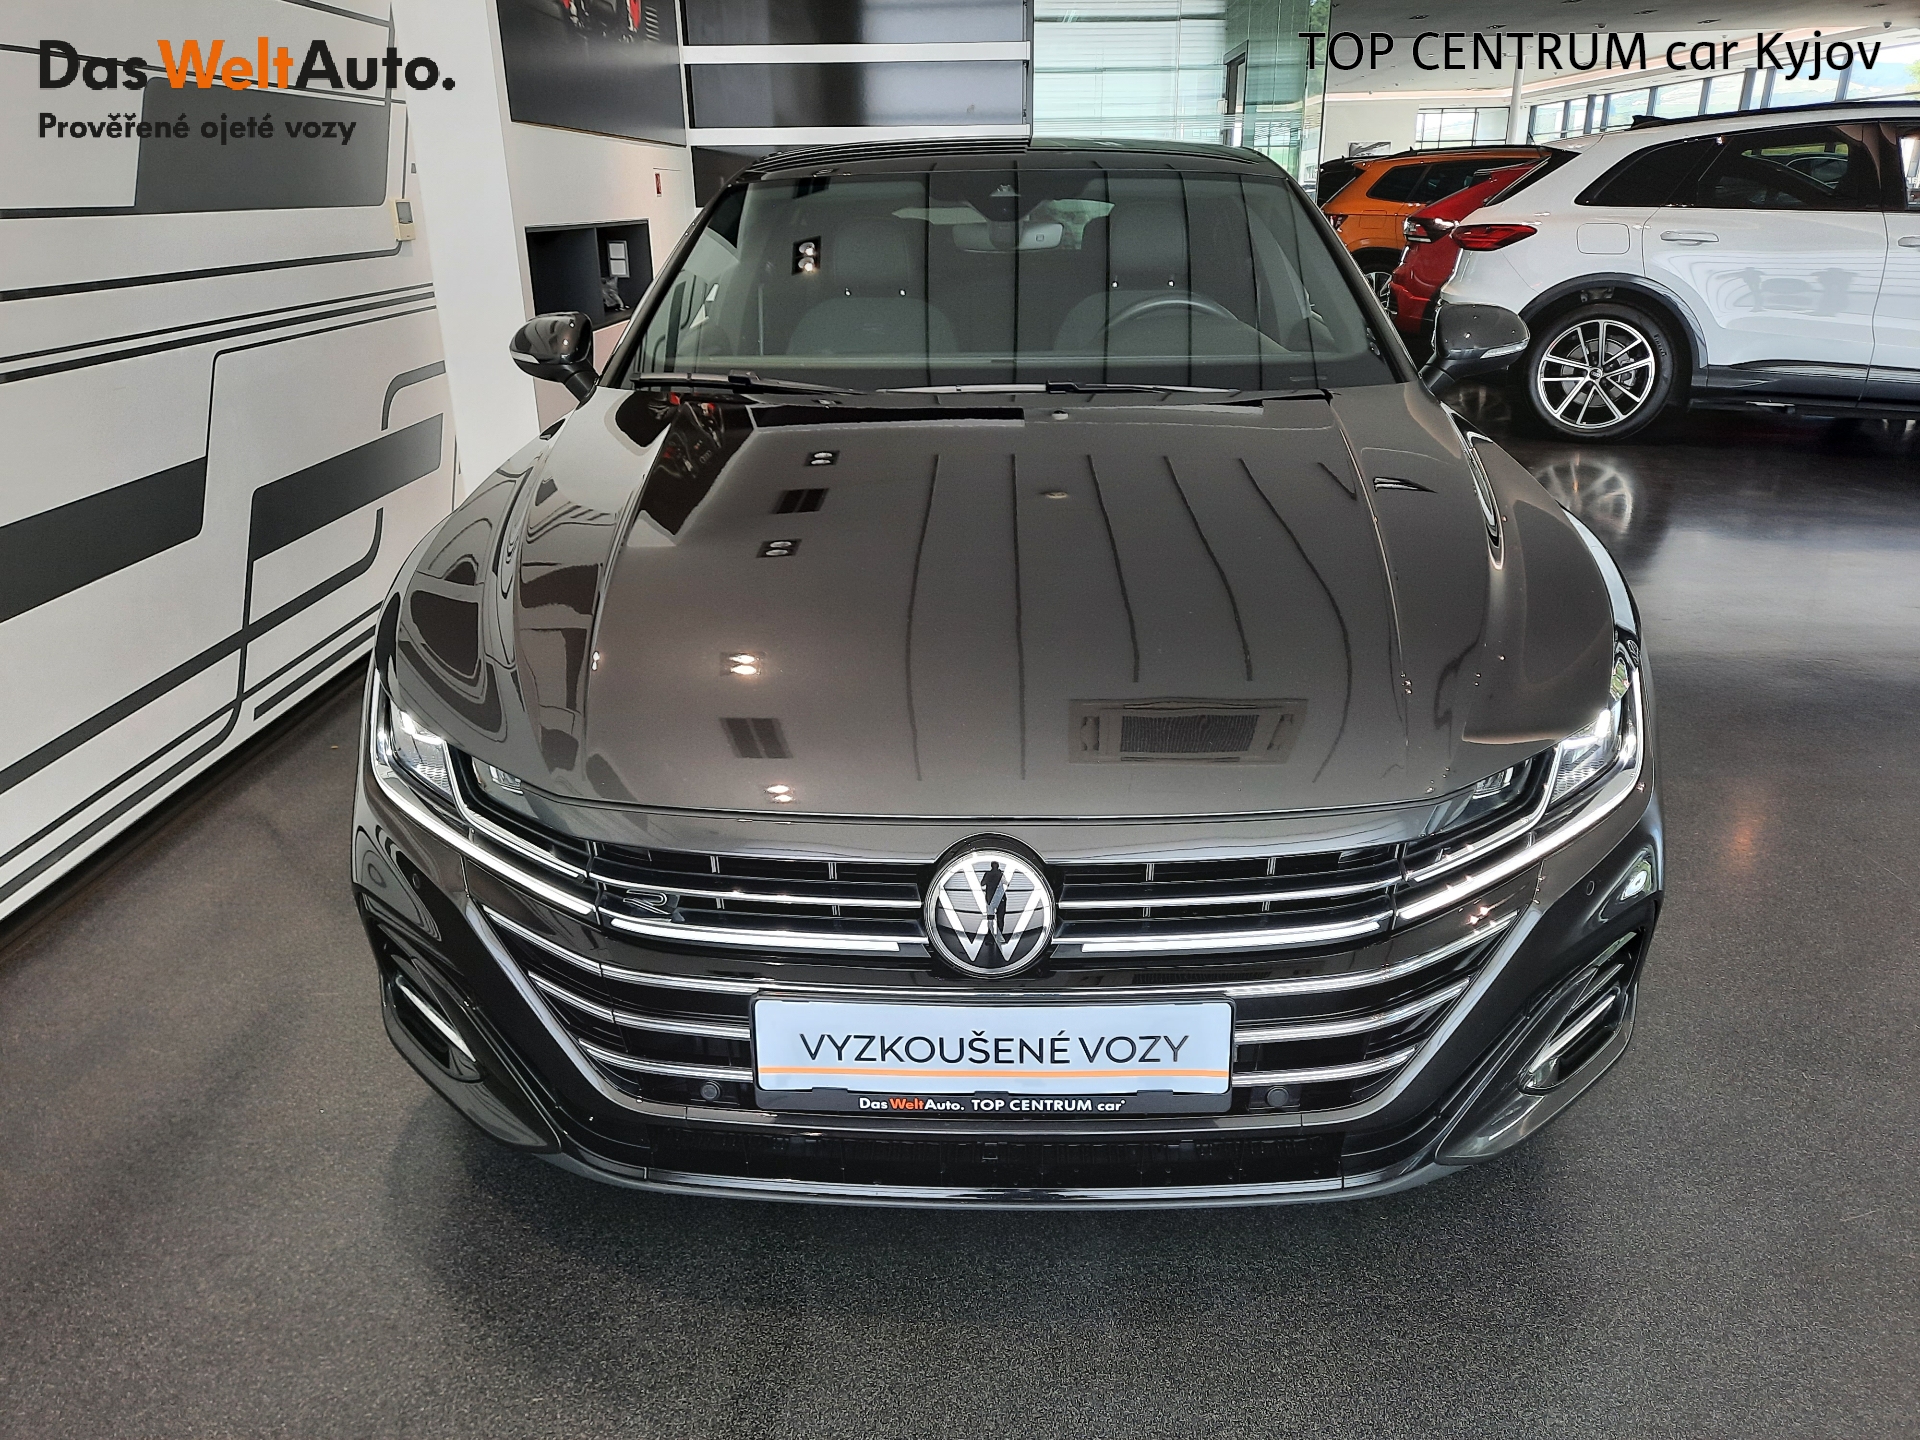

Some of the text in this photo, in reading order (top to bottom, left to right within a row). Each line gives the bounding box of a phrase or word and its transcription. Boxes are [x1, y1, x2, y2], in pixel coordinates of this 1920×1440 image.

[799, 1030, 1189, 1064] VYZKOUŠENÉ VOZY
[971, 1099, 1005, 1111] TOP
[1009, 1099, 1093, 1111] CENTRUM
